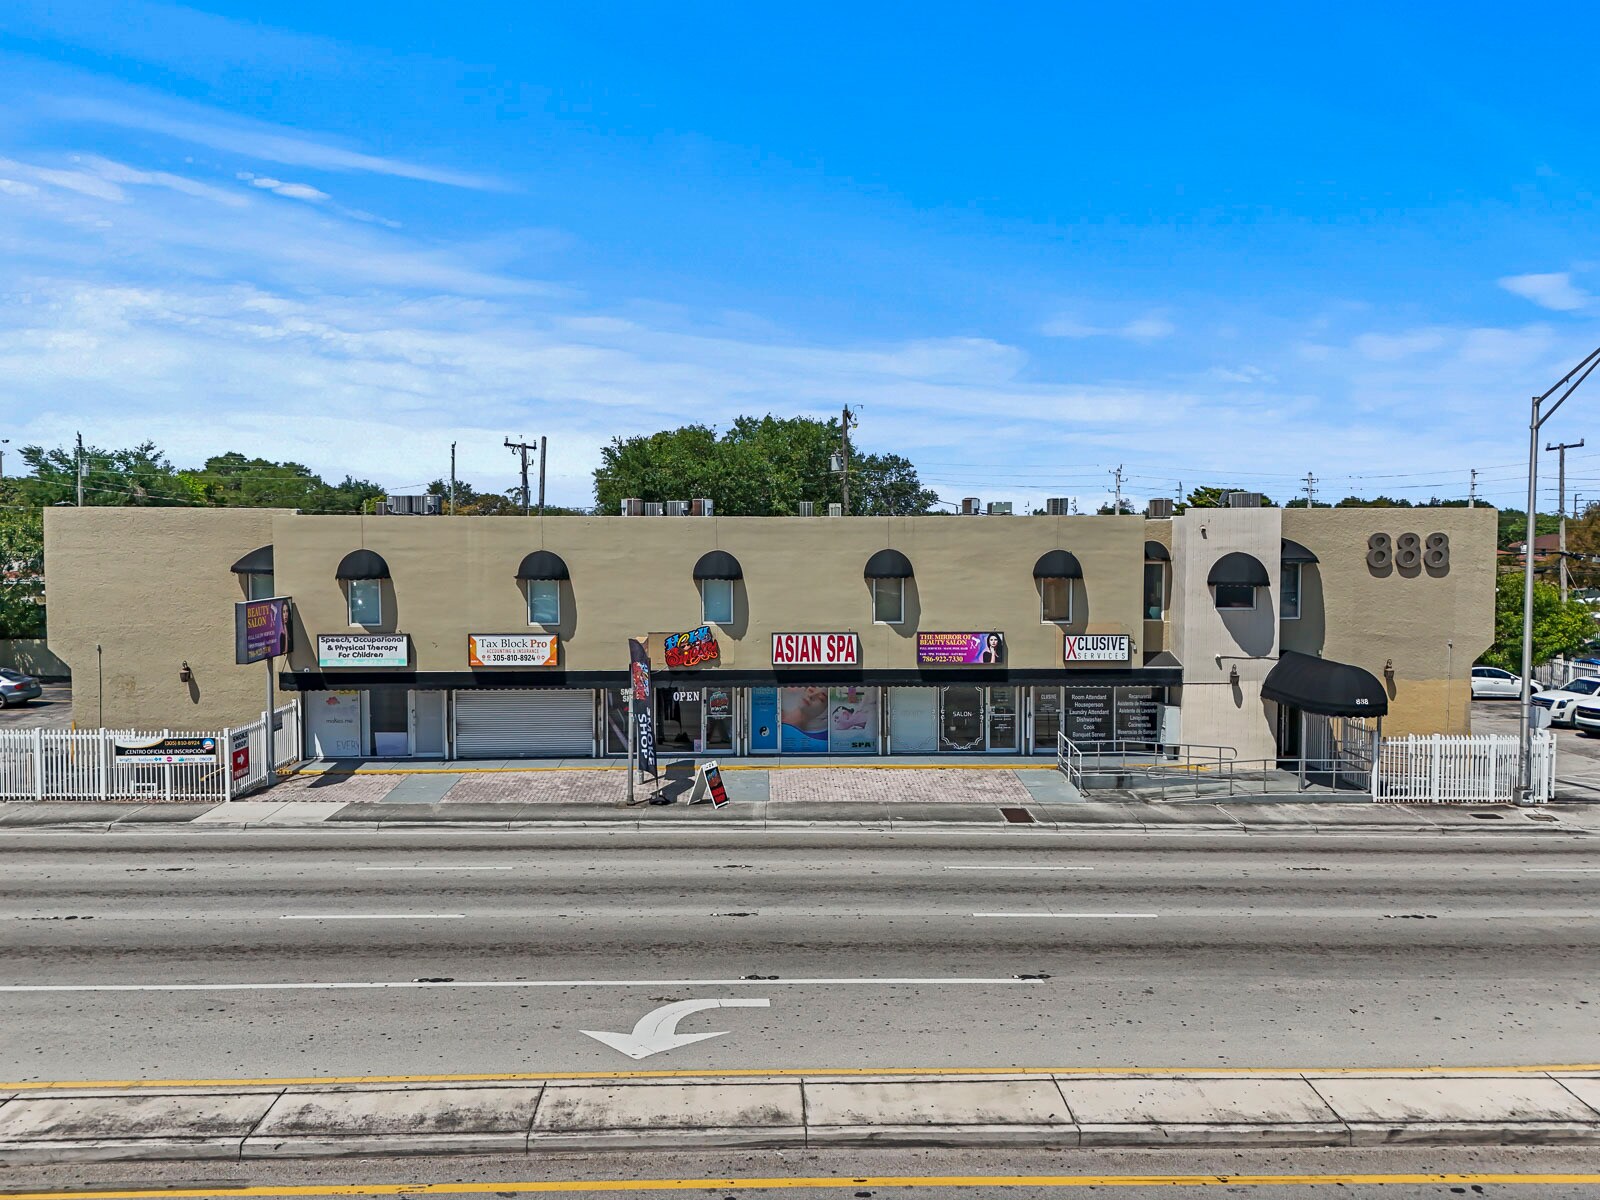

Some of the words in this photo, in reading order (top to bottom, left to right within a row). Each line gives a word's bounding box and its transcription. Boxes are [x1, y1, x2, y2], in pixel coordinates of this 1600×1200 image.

[1367, 532, 1450, 568] 888
[248, 605, 270, 617] BEAUTY
[248, 616, 267, 628] SALON
[321, 636, 351, 644] Speech,
[353, 636, 404, 644] Occupational
[479, 638, 499, 648] Tax
[501, 638, 528, 648] Block
[530, 639, 548, 648] Pro
[335, 645, 365, 653] Physical
[774, 635, 822, 662] ASIAN
[827, 634, 856, 662] SPA
[1066, 636, 1126, 660] XCLUSIVE
[493, 654, 536, 662] 305-810-8924
[673, 691, 700, 701] OPEN
[638, 713, 648, 759] SHOP
